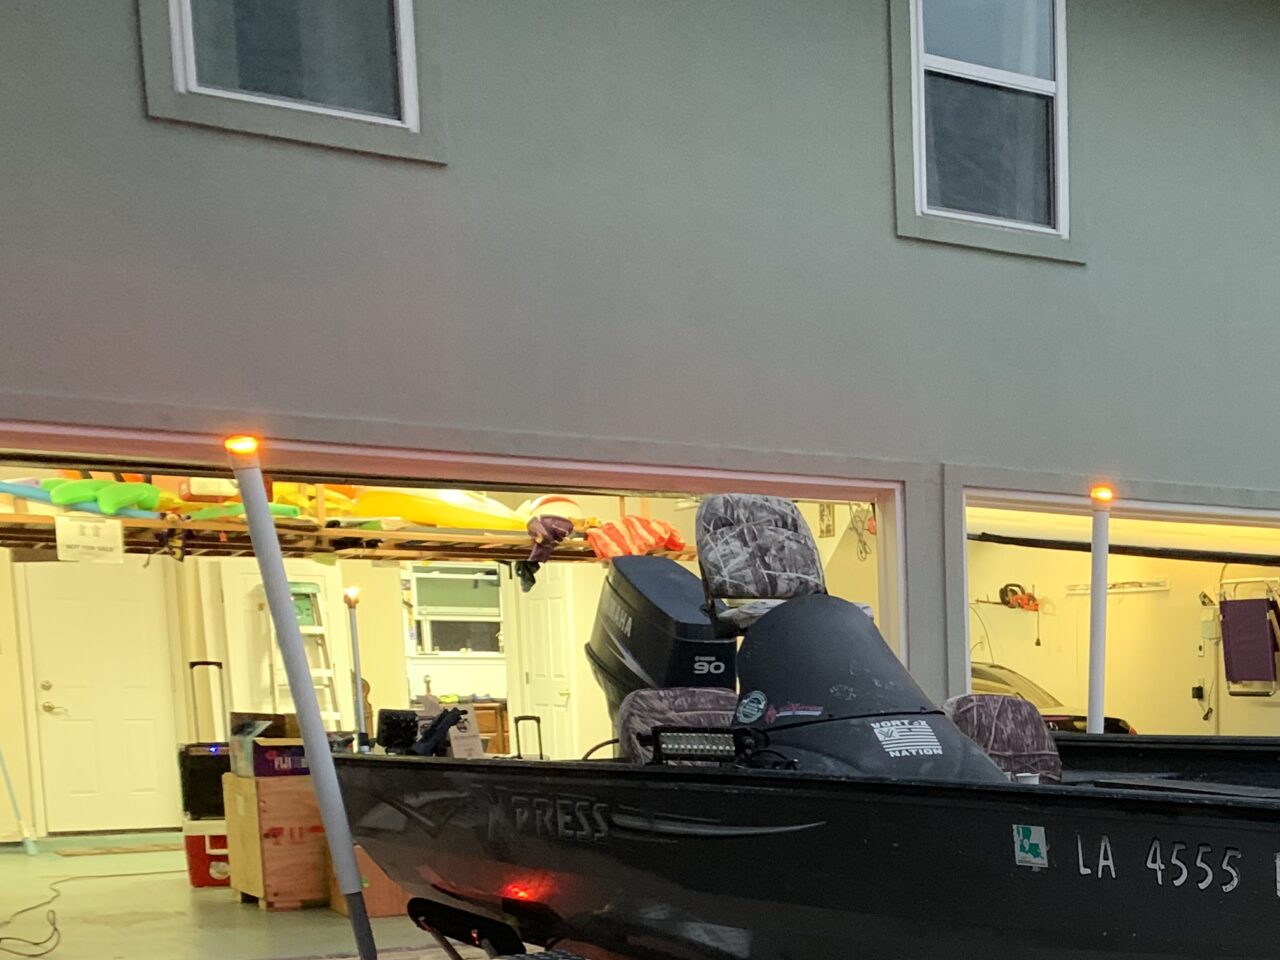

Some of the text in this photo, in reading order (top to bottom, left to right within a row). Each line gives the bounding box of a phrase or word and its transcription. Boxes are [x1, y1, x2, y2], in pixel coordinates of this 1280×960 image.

[693, 661, 725, 675] 90
[888, 748, 943, 758] NATION
[1076, 833, 1117, 879] LA
[1146, 836, 1242, 893] 4555
